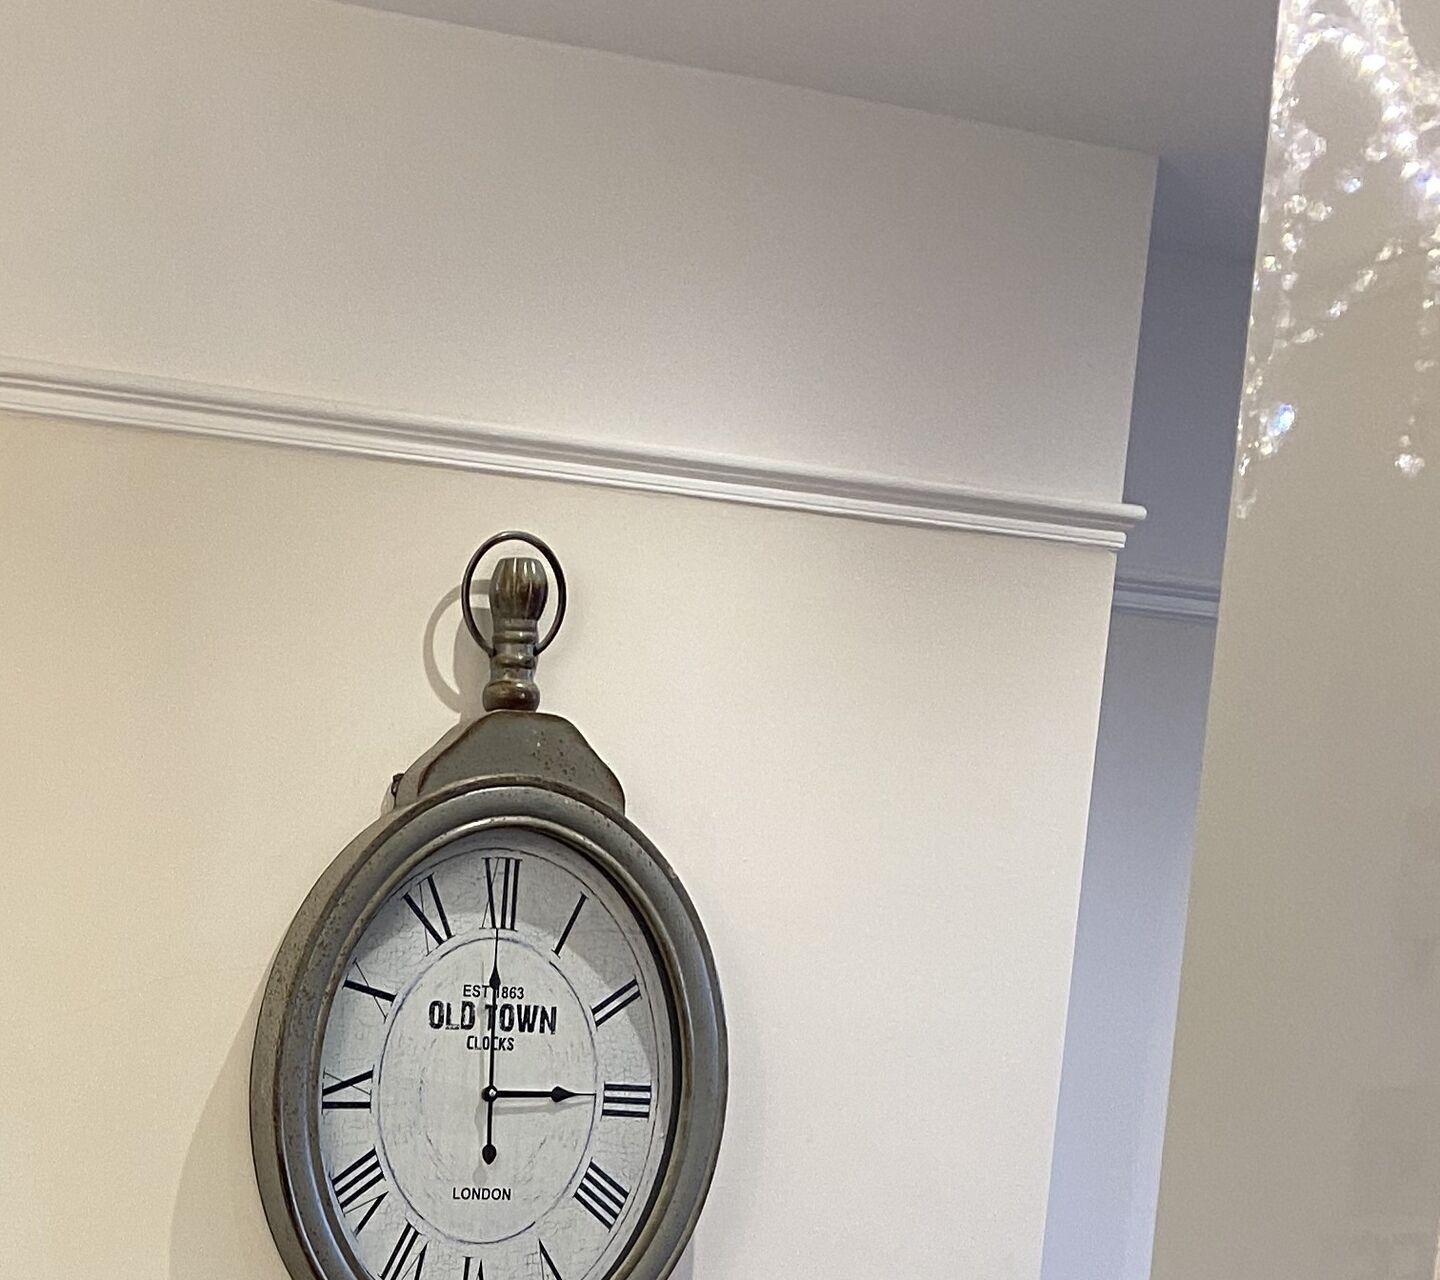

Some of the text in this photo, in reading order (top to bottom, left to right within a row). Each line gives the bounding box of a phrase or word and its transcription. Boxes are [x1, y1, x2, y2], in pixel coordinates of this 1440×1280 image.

[402, 872, 456, 957] XI
[479, 857, 522, 932] XII
[342, 958, 398, 1021] X
[462, 984, 490, 999] EST
[589, 975, 642, 1031] II
[428, 1000, 557, 1034] OLD TOWN
[466, 1035, 515, 1051] CLOCKS
[321, 1064, 375, 1115] IX
[601, 1081, 652, 1122] III
[452, 1187, 512, 1201] LONDON
